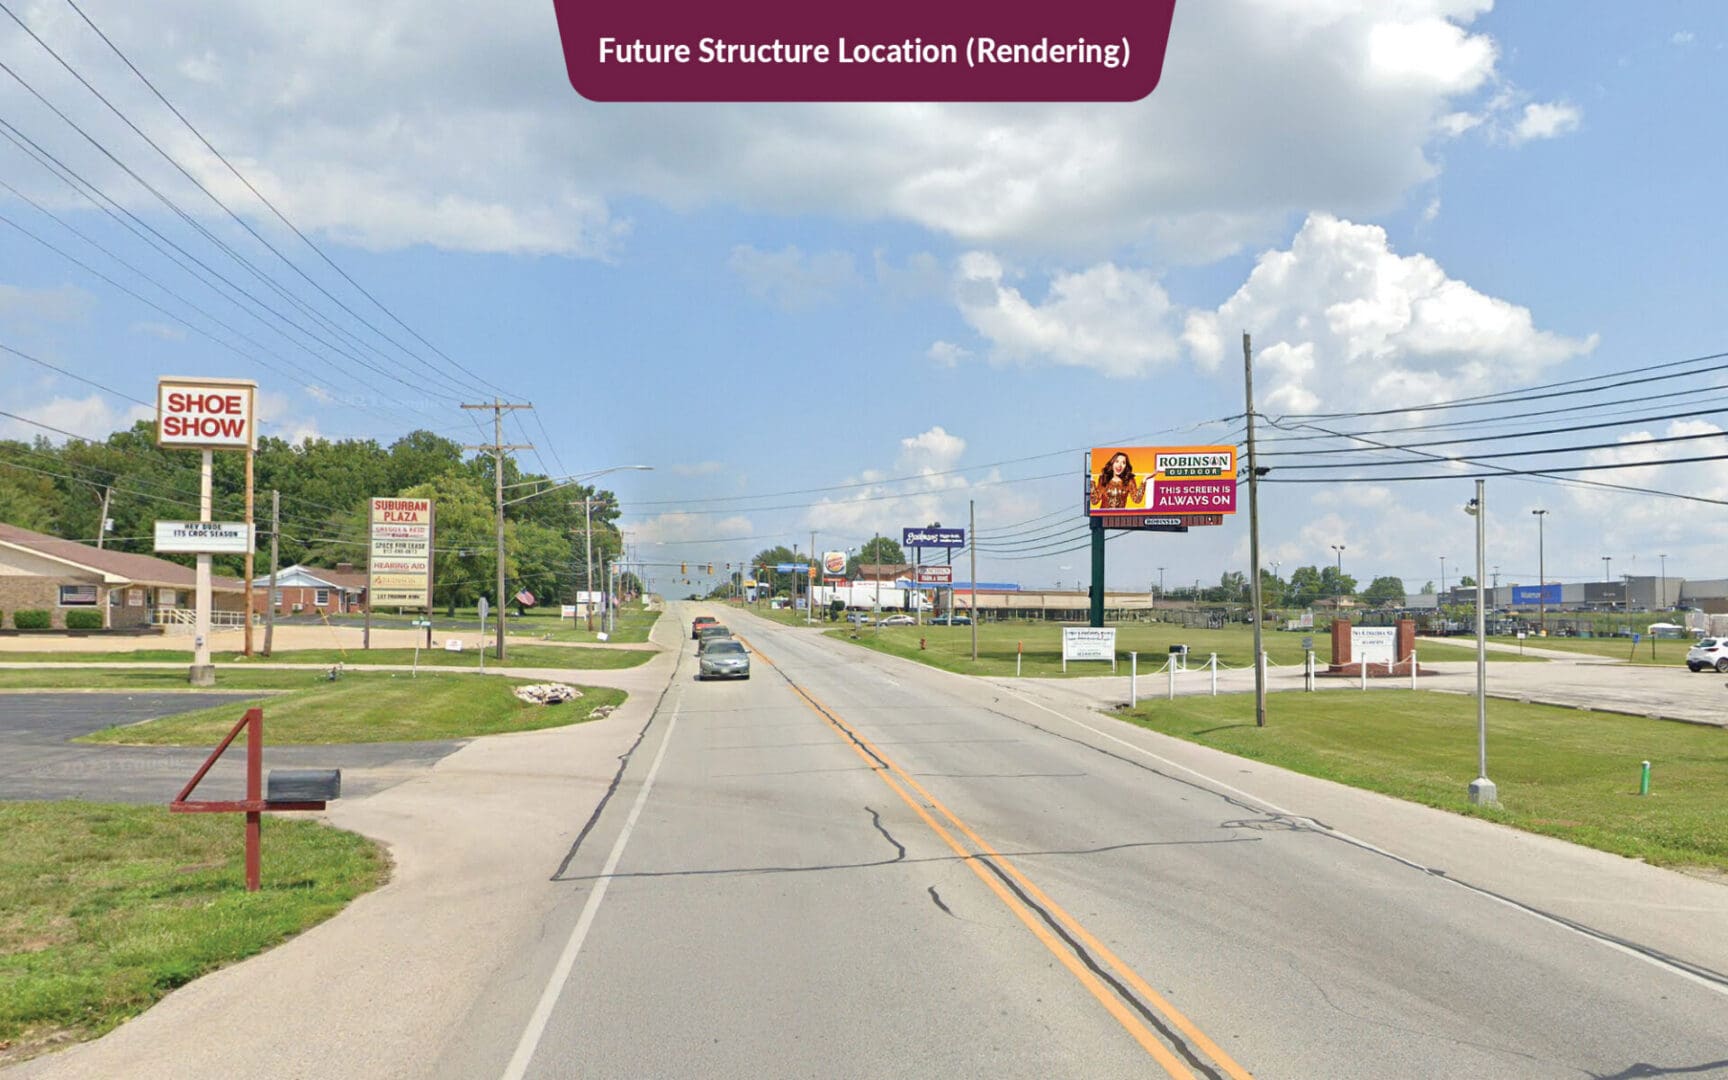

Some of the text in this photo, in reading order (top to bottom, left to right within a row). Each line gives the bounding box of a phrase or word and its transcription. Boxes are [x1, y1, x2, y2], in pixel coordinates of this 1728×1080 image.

[168, 394, 241, 414] SHOE
[164, 417, 244, 437] SHOW
[1183, 486, 1220, 494] SCREEN
[1222, 485, 1231, 493] IS
[1159, 495, 1231, 506] ALWAYS ON
[375, 501, 427, 511] SUBURBAN
[384, 511, 418, 521] PLAZA
[374, 562, 426, 570] HEARING AID
